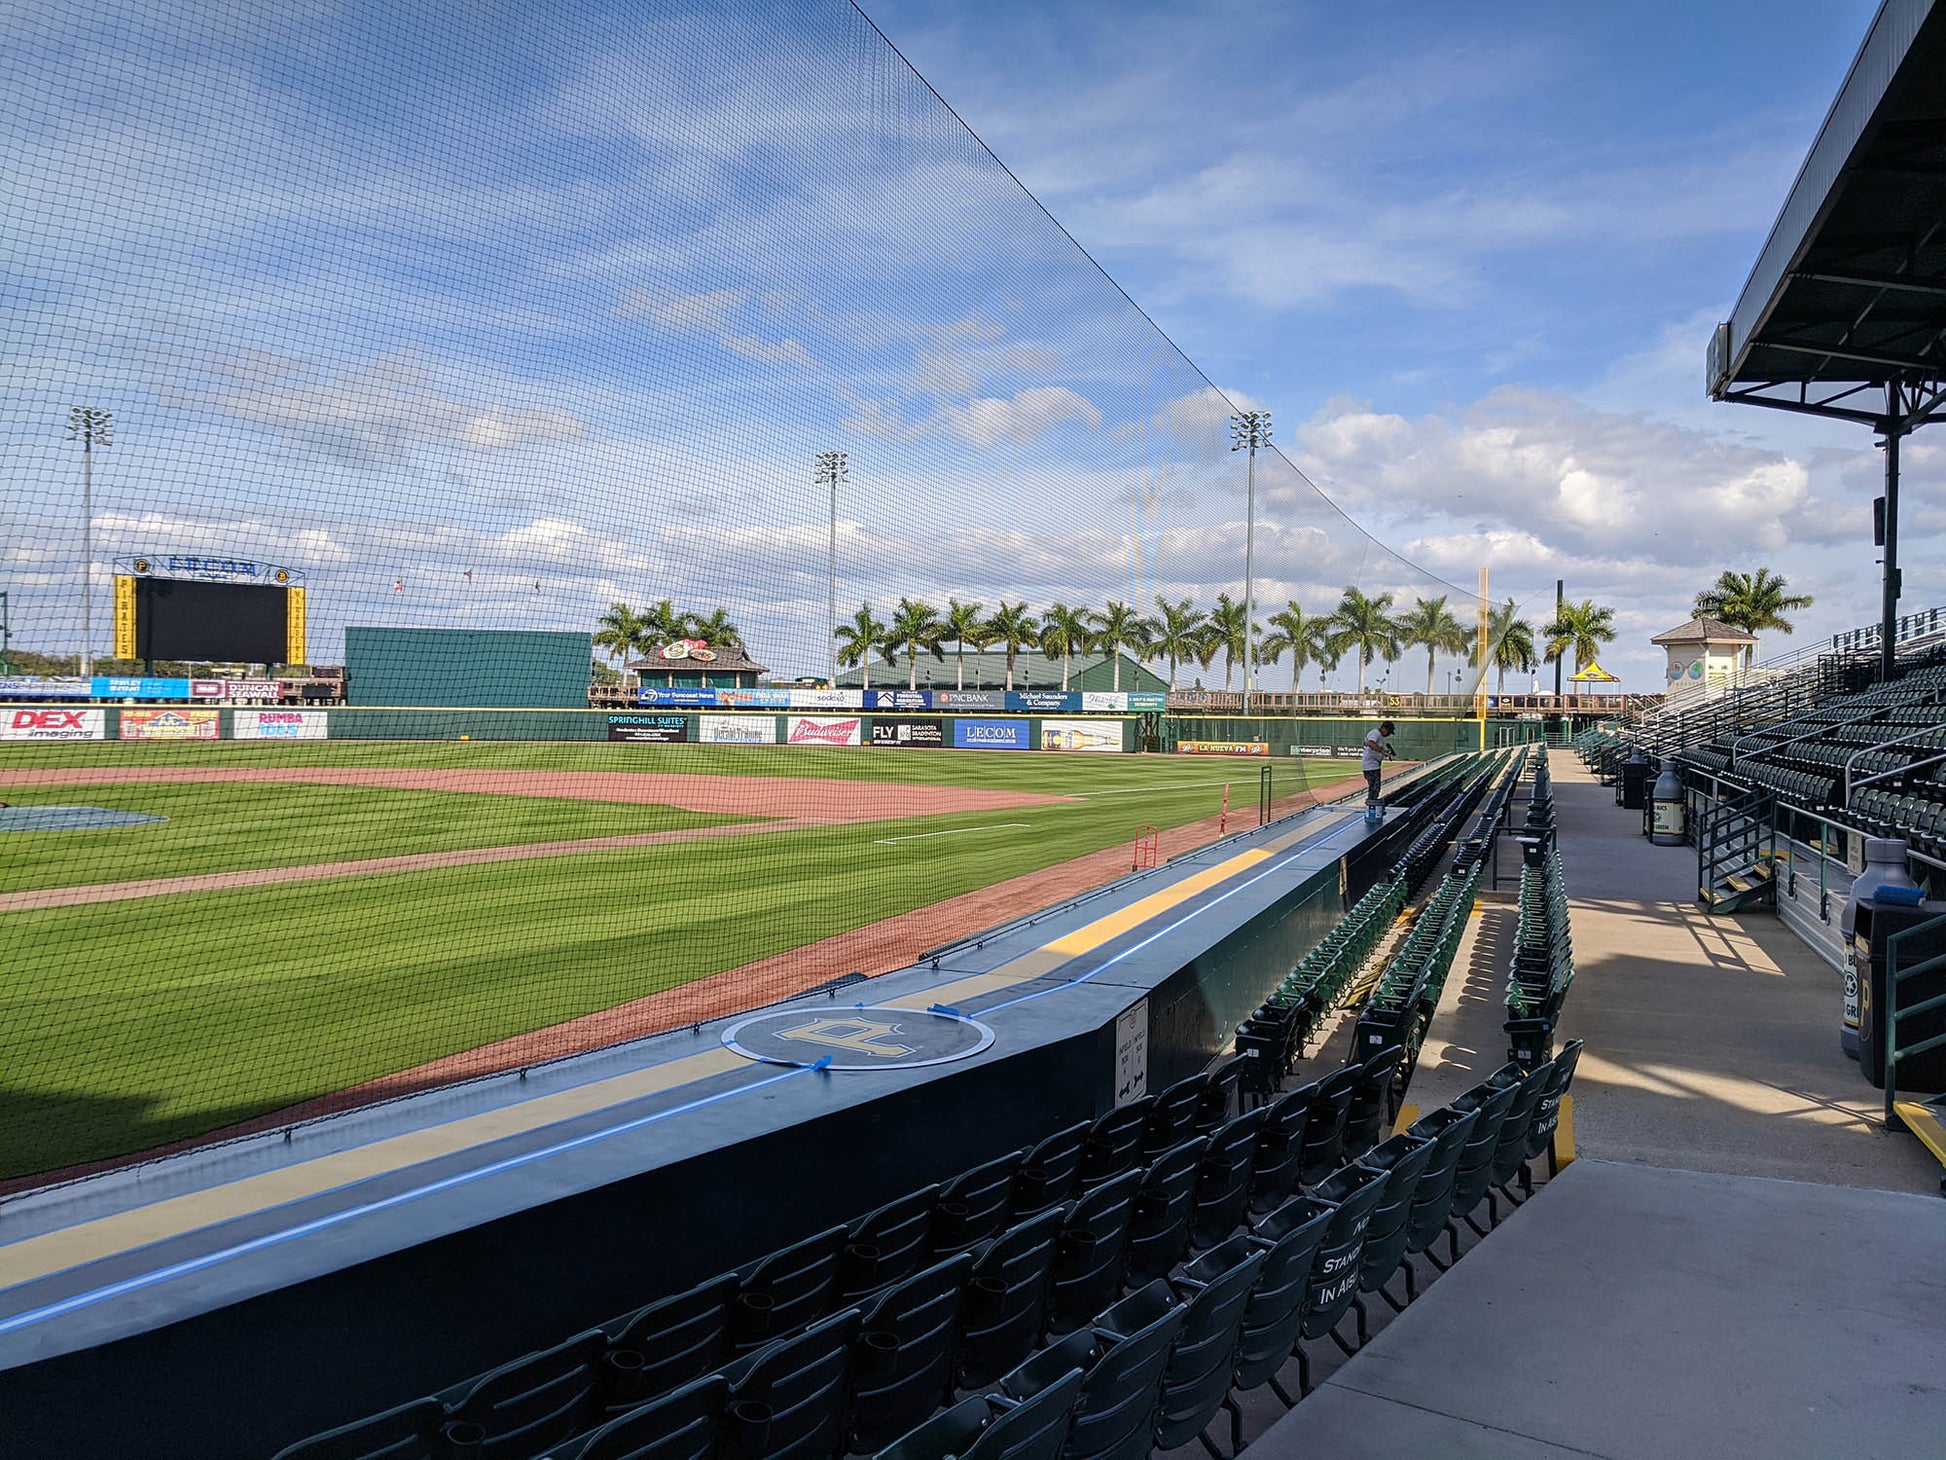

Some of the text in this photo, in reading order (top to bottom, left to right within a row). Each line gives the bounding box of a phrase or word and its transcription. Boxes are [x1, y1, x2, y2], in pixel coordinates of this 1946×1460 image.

[229, 684, 280, 692] DUNCAN
[12, 711, 88, 729] DEX
[259, 713, 303, 724] RUMBA
[609, 716, 685, 725] SPRINGHILL SUITES
[28, 729, 94, 739] imaging
[796, 723, 853, 737] Budweiser
[873, 726, 895, 739] FLY
[966, 726, 1017, 739] LECOM
[1319, 1286, 1336, 1305] IN
